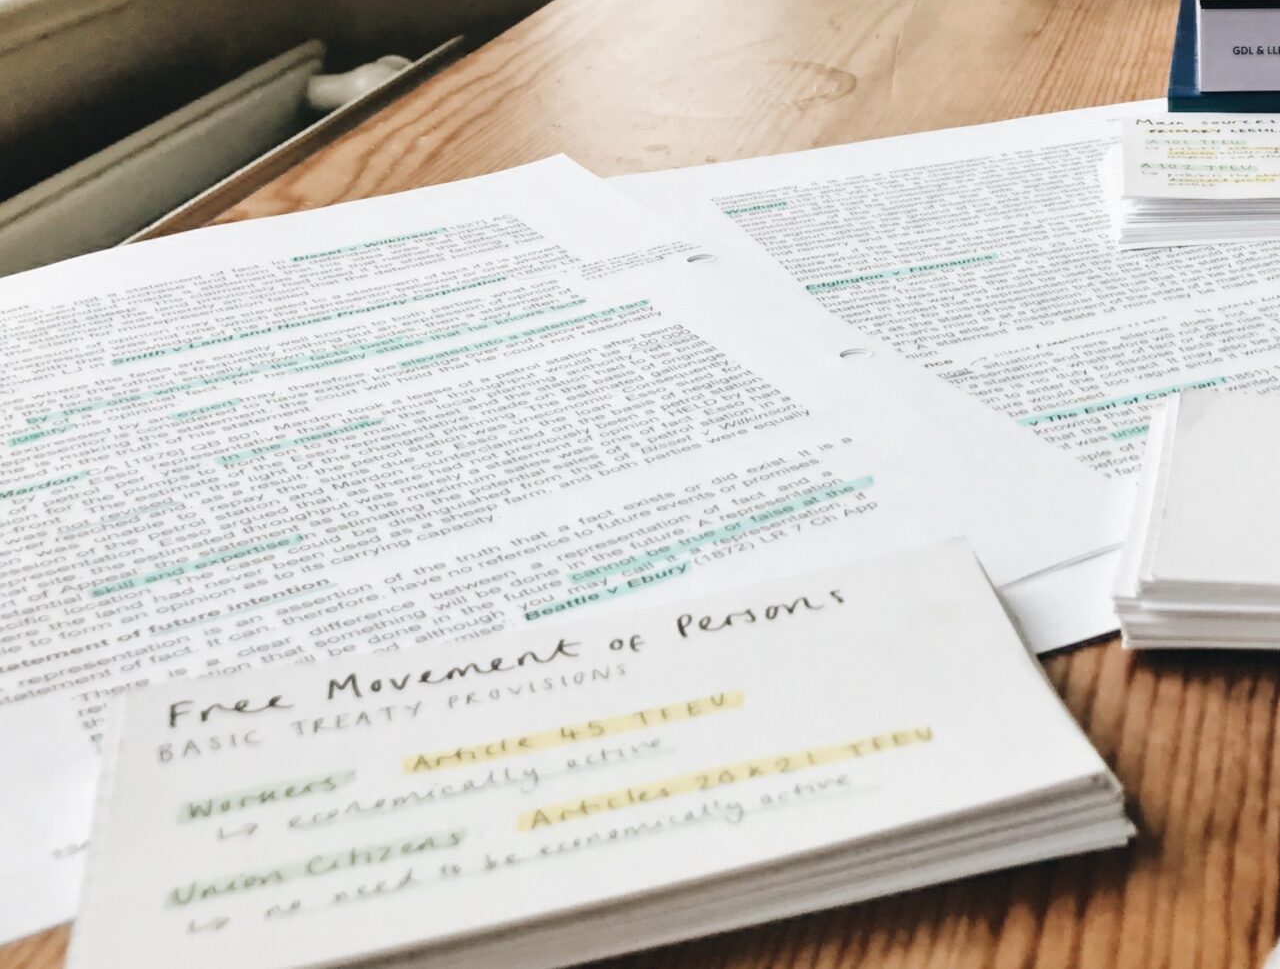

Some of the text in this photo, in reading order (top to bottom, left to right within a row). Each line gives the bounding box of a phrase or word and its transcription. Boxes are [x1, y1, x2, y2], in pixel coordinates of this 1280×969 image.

[1232, 45, 1254, 55] GDL
[1256, 45, 1265, 55] &
[112, 348, 166, 365] Smith
[188, 334, 233, 350] Land
[240, 327, 272, 339] and
[278, 313, 333, 331] House
[337, 298, 407, 319] Property
[411, 276, 507, 301] Corporation
[806, 274, 884, 291] Edgington
[92, 537, 291, 598] skill and expertise
[524, 500, 880, 622] Beattie v Ebury (1872) LR 7 Ch App
[571, 484, 856, 582] cannot be true or false at the
[117, 576, 330, 643] of future intention
[167, 588, 847, 730] Free Movement of Persons
[157, 661, 628, 766] BASIC TREATY PROVISIONS
[186, 691, 727, 821] Workers Article 45 TFEU
[288, 736, 663, 831] economically active
[304, 830, 464, 876] Citizens
[530, 784, 671, 830] Articles
[844, 726, 934, 759] TFEU
